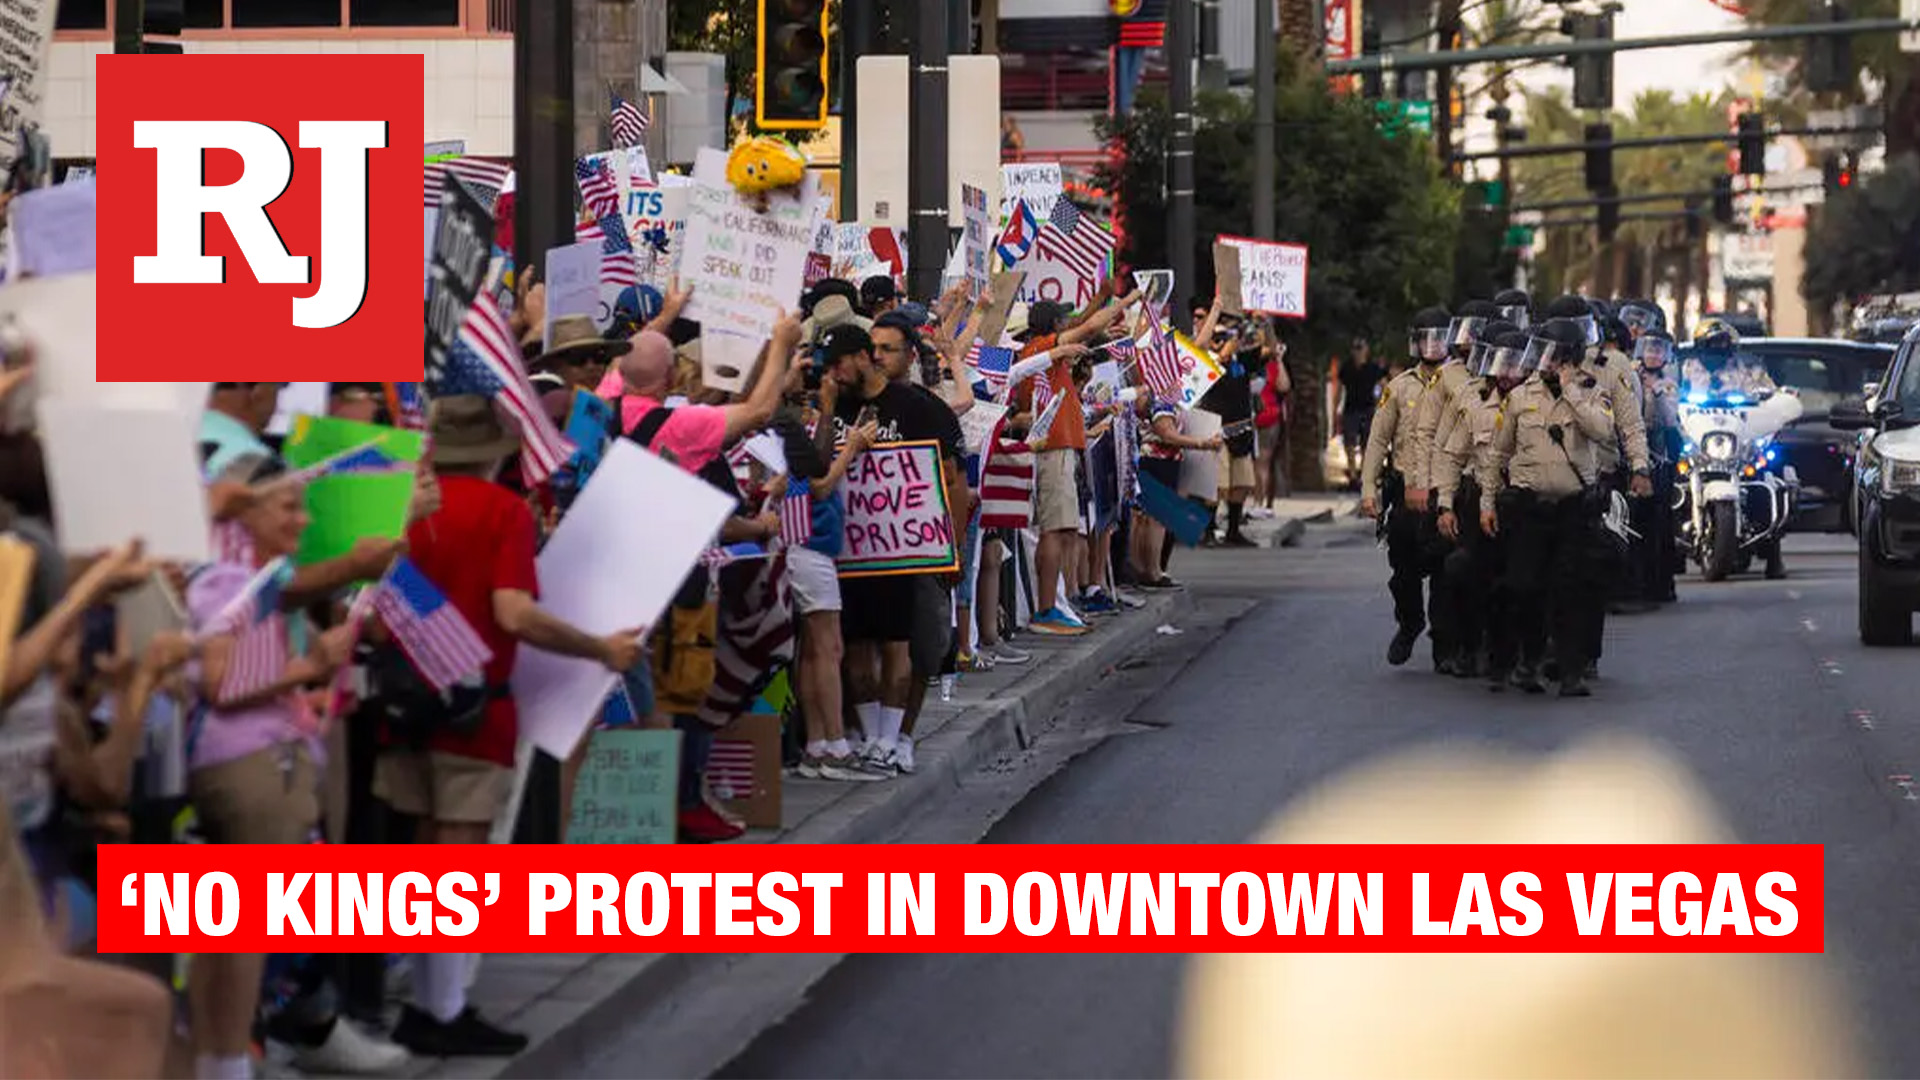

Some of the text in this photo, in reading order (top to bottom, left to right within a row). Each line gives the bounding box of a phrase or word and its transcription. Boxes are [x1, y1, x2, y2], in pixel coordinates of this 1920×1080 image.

[627, 192, 663, 216] ITS
[847, 450, 922, 485] EACH
[848, 484, 931, 517] MOVE
[845, 516, 951, 556] PRISON
